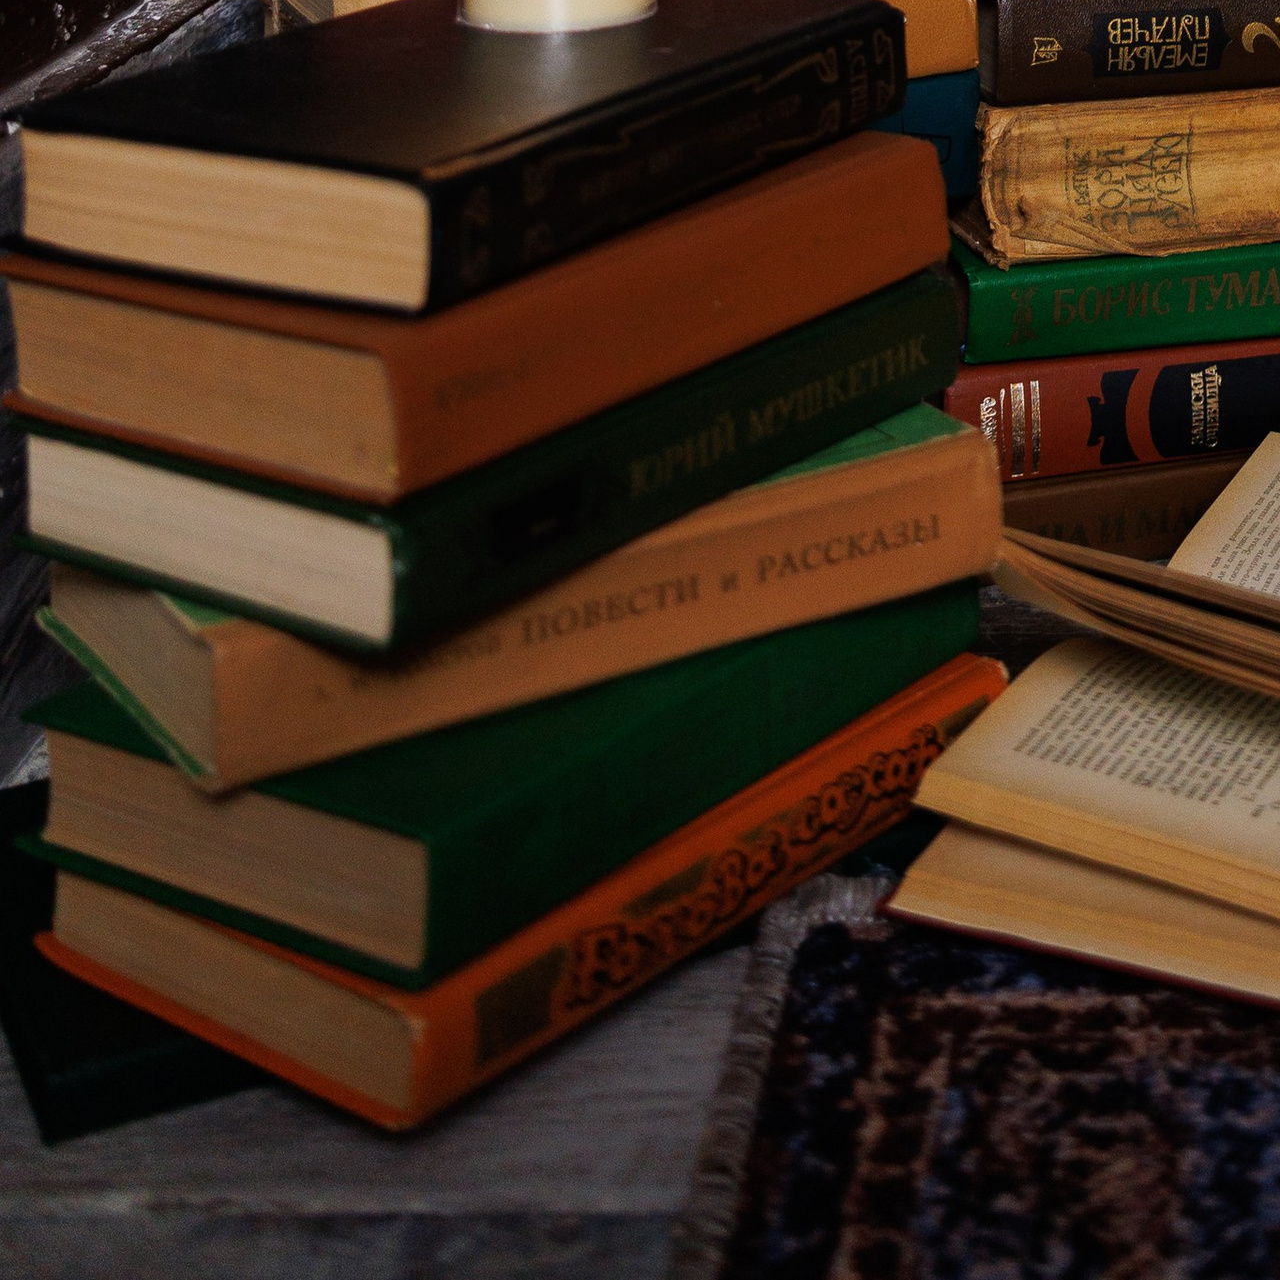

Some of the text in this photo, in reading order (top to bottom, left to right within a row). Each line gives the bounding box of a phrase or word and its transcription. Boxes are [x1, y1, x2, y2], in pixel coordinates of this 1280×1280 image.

[1107, 14, 1210, 44] ПУГАЧЕВ
[1107, 42, 1209, 72] ЕМЕЛЬЯН
[1053, 281, 1172, 326] БОРИС
[628, 413, 740, 500] ЮРИЙ
[747, 334, 930, 443] МУШКЕТИК
[1190, 370, 1205, 446] ЗАПИСКИ
[521, 573, 701, 647] ПОВЕСТИ
[756, 512, 942, 586] РАССКАЗЫ
